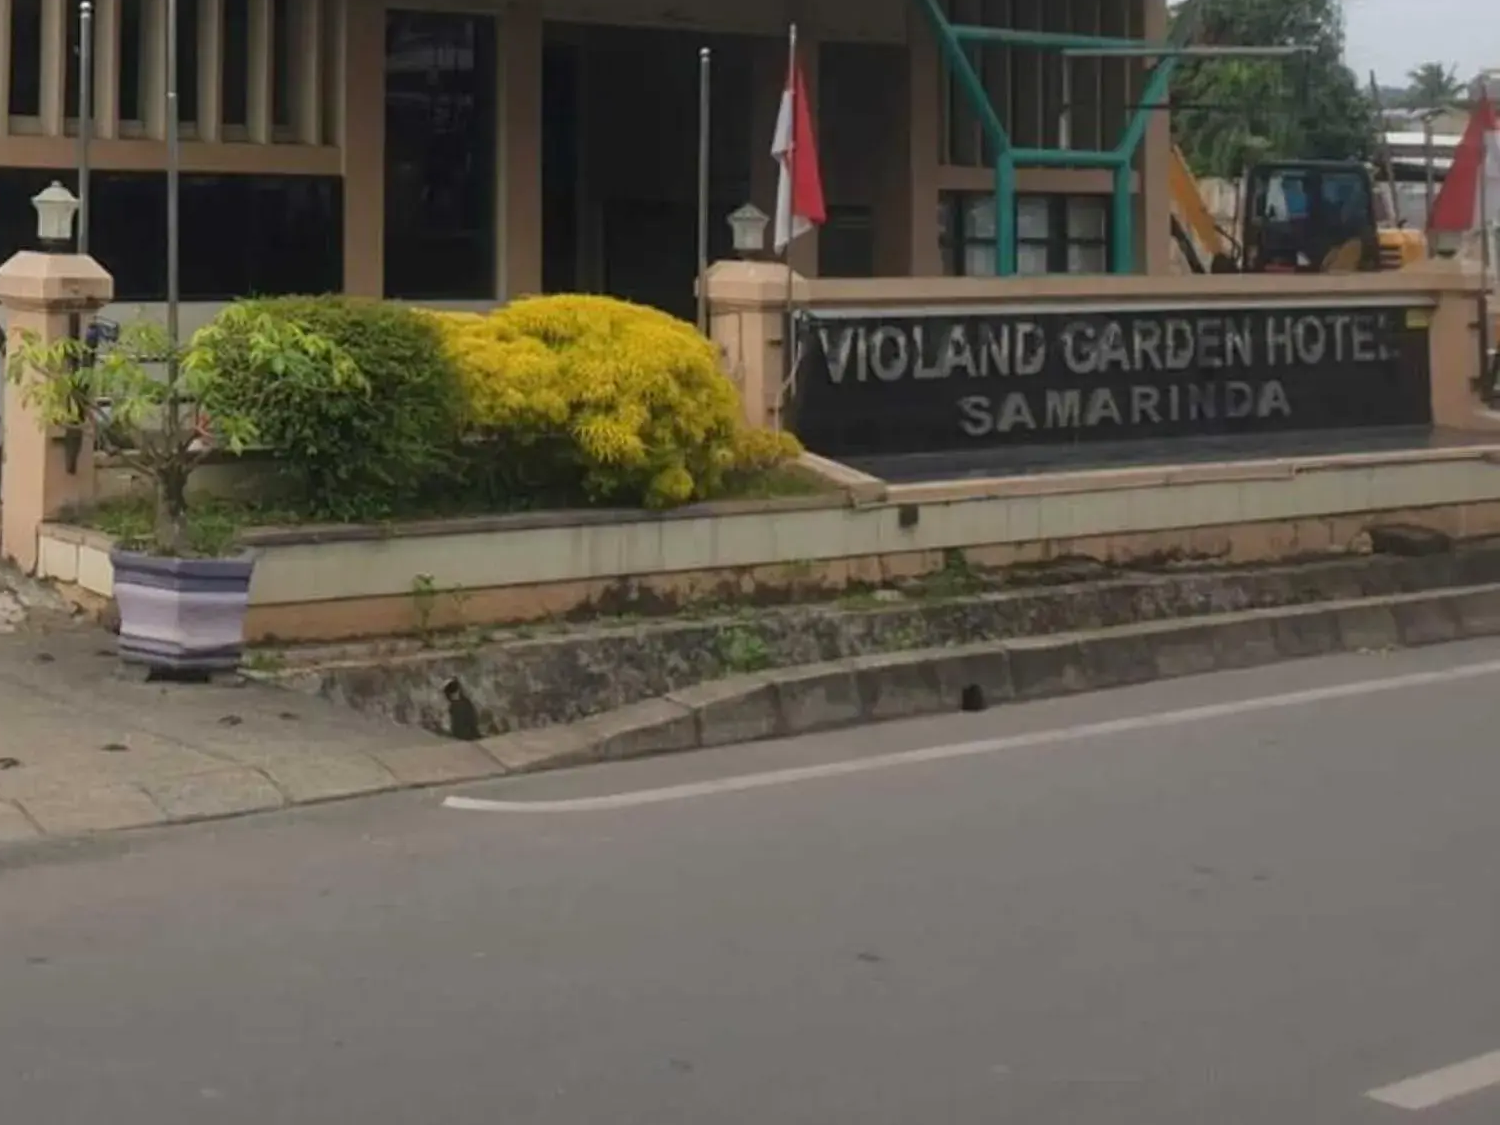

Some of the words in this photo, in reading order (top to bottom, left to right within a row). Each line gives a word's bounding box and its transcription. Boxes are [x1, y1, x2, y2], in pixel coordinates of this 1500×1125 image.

[818, 322, 1046, 383] VIOLAND
[1060, 316, 1252, 373] GARDEN
[957, 379, 1292, 436] SAMARINDA
